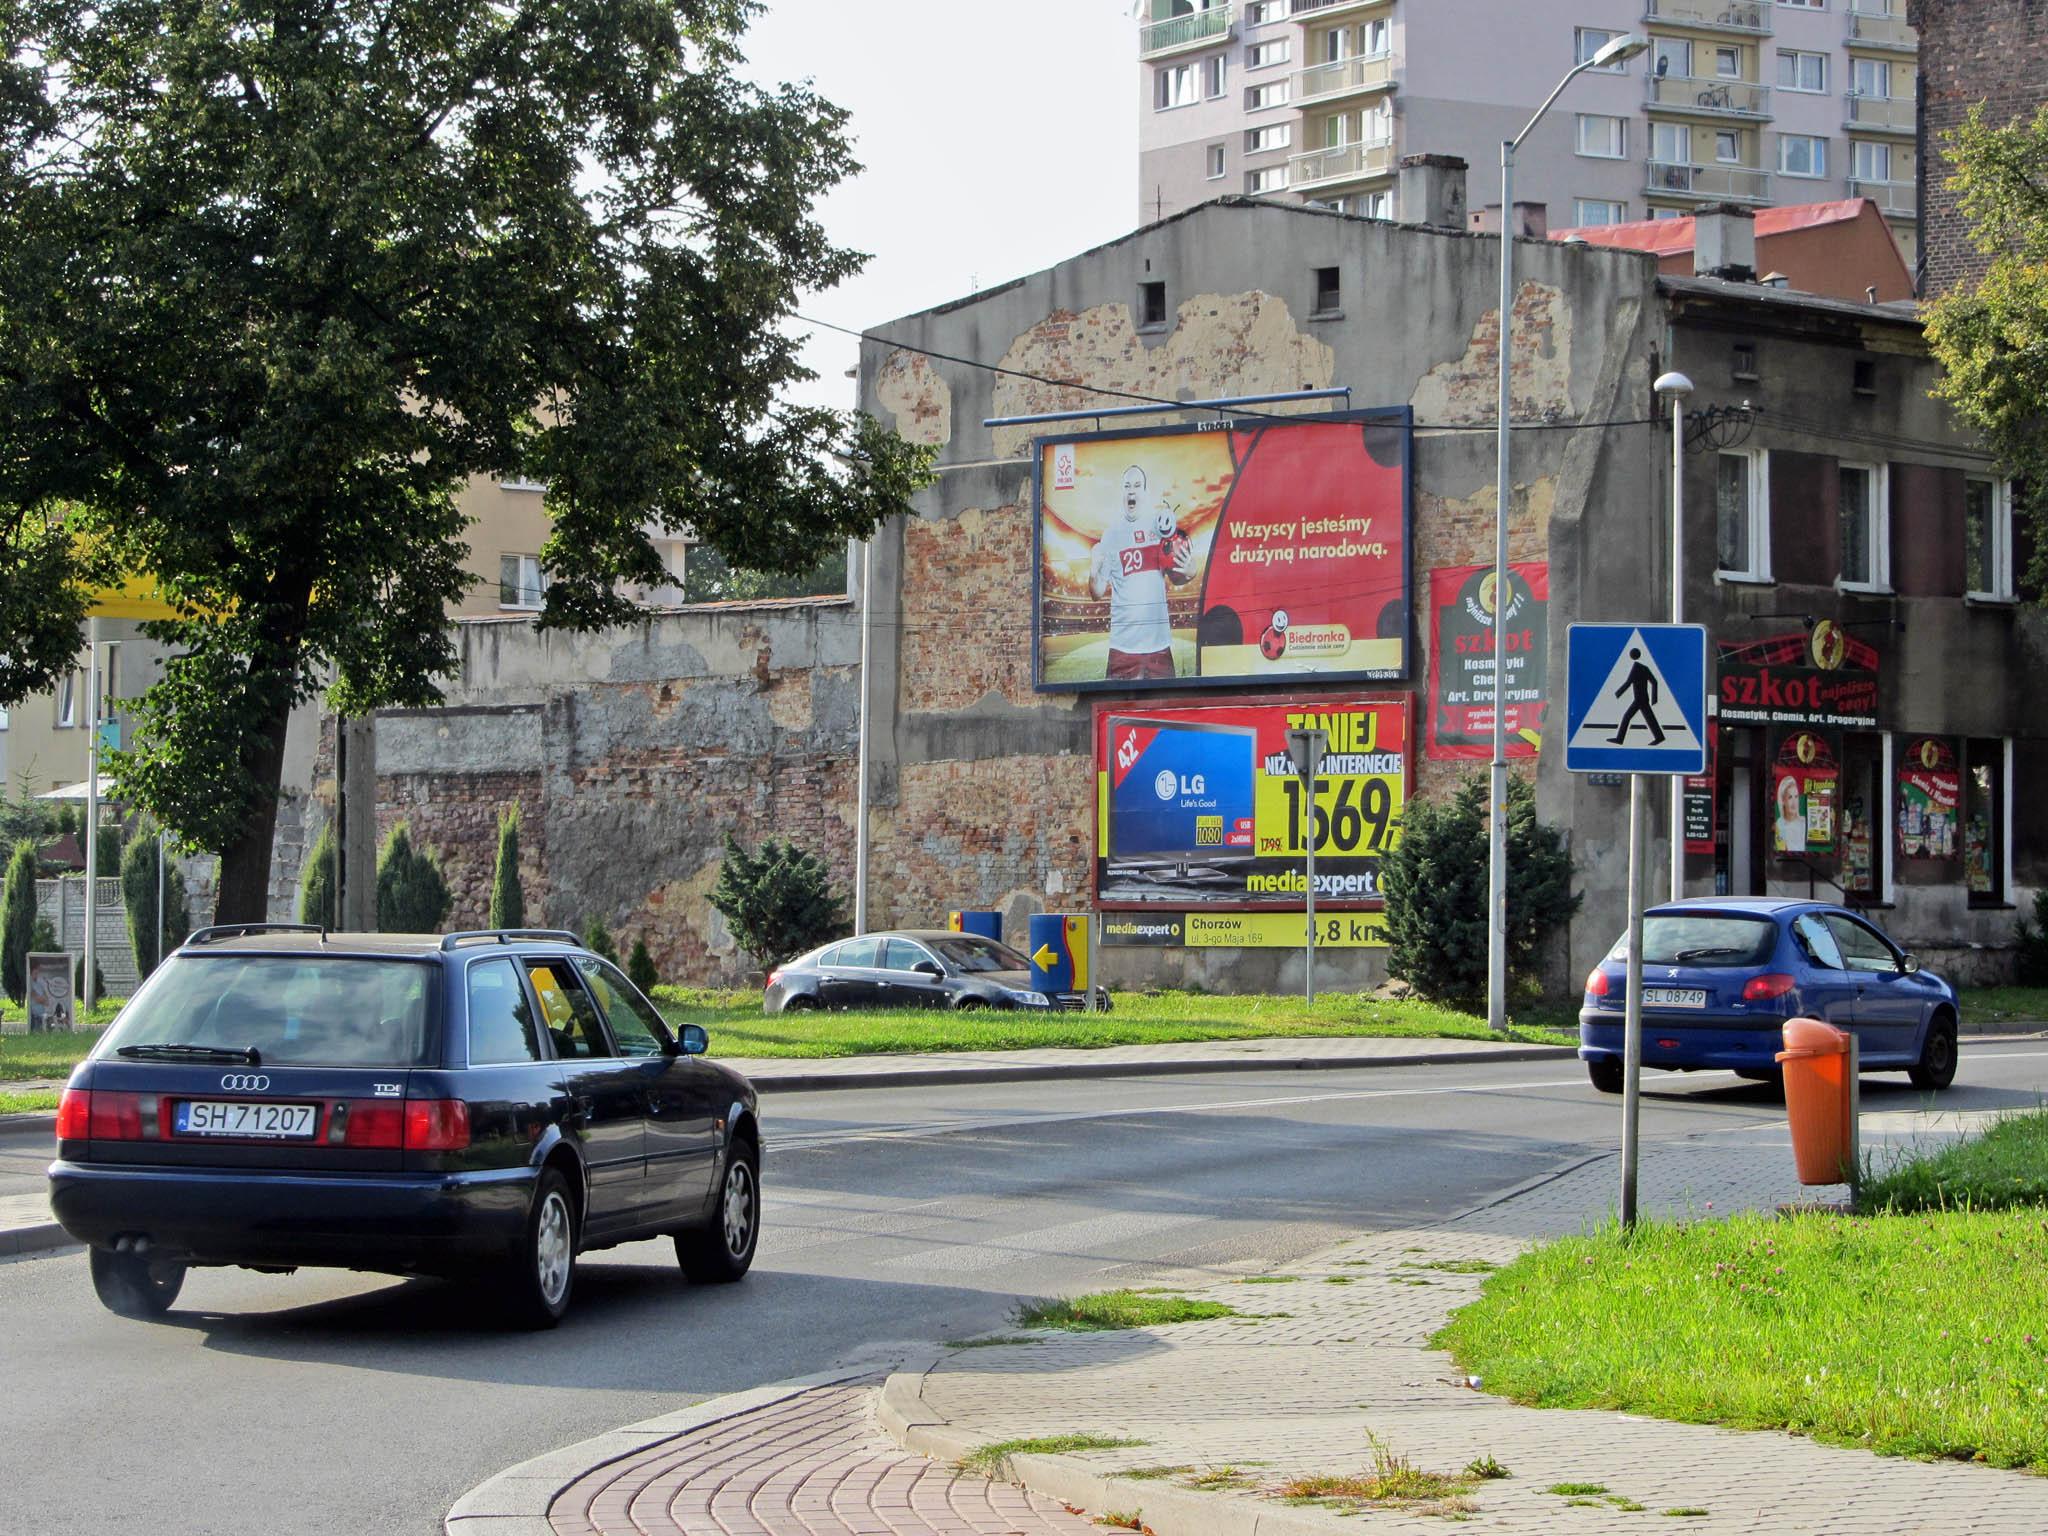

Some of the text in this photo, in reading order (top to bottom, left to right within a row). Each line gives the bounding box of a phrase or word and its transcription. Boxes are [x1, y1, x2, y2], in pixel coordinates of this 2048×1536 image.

[1229, 513, 1372, 542] Wszyscy jesteśmy
[1230, 537, 1388, 567] drużyną narodową.
[1123, 549, 1143, 573] 29
[1289, 631, 1345, 643] Biedronka
[1464, 656, 1524, 671] Kosmyki
[1472, 673, 1515, 686] Cheia
[1447, 688, 1540, 702] Art. Droryjne
[1721, 668, 1823, 709] szkot
[1808, 714, 1825, 723] Art.
[1827, 715, 1876, 726] Drogeryjne
[1265, 752, 1287, 775] NIŻ
[1326, 754, 1401, 775] INTERNECIE
[1181, 774, 1205, 795] LG
[1181, 799, 1217, 808] Life's Good
[1197, 827, 1221, 844] 1080
[1247, 868, 1374, 897] mediaexpert
[1106, 922, 1170, 937] mediaexpert
[1191, 918, 1242, 930] Chorzów
[1203, 934, 1223, 946] 3-go
[1224, 934, 1246, 945] Maja
[1248, 933, 1263, 944] 169
[1645, 990, 1704, 1004] SL 08749
[373, 1084, 402, 1092] TDI
[192, 1104, 226, 1129] SH
[235, 1106, 310, 1132] 71207
